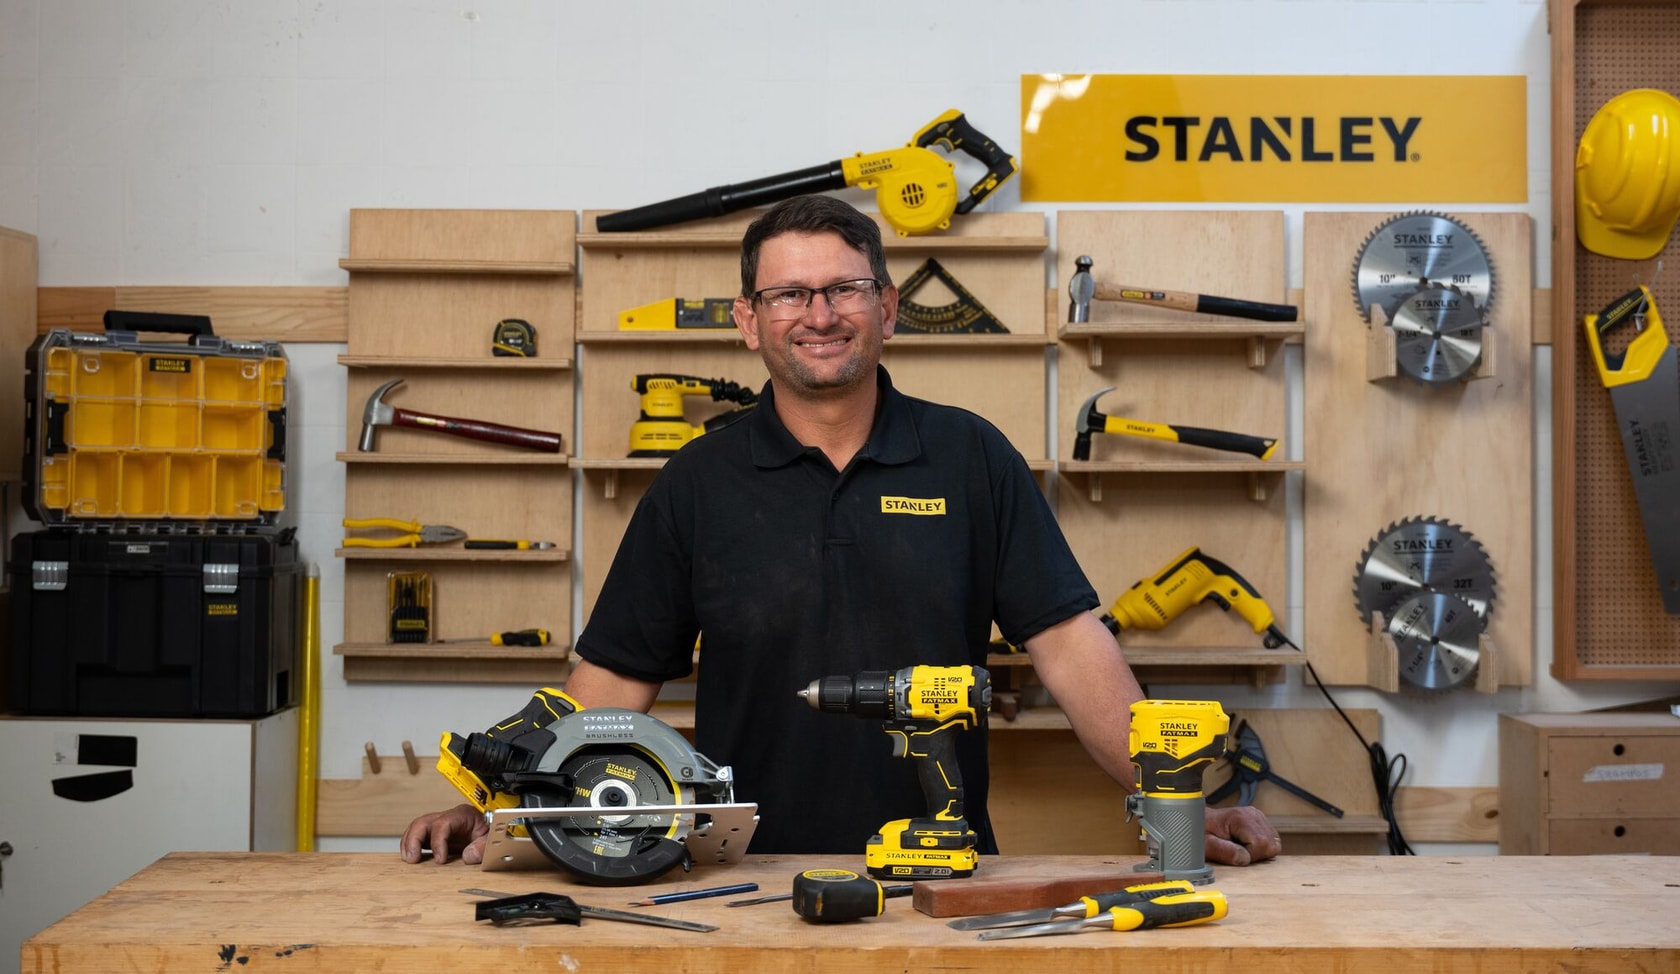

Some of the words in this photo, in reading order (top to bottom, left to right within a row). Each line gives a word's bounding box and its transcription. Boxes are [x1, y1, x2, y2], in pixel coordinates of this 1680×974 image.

[859, 158, 891, 169] STANLEY
[1394, 234, 1453, 244] STANLEY
[1379, 274, 1396, 284] 10"
[1415, 300, 1459, 308] STANLEY
[1606, 298, 1632, 320] STANLEY
[1126, 424, 1155, 433] STANLEY
[1629, 420, 1652, 476] STANLEY
[885, 499, 942, 513] STANLEY
[1394, 540, 1453, 551] STANLEY
[1381, 581, 1397, 591] 10"
[1454, 578, 1473, 589] 32T
[1396, 602, 1424, 640] STANLEY
[1160, 722, 1198, 730] STANLEY
[607, 763, 637, 776] STANLEY
